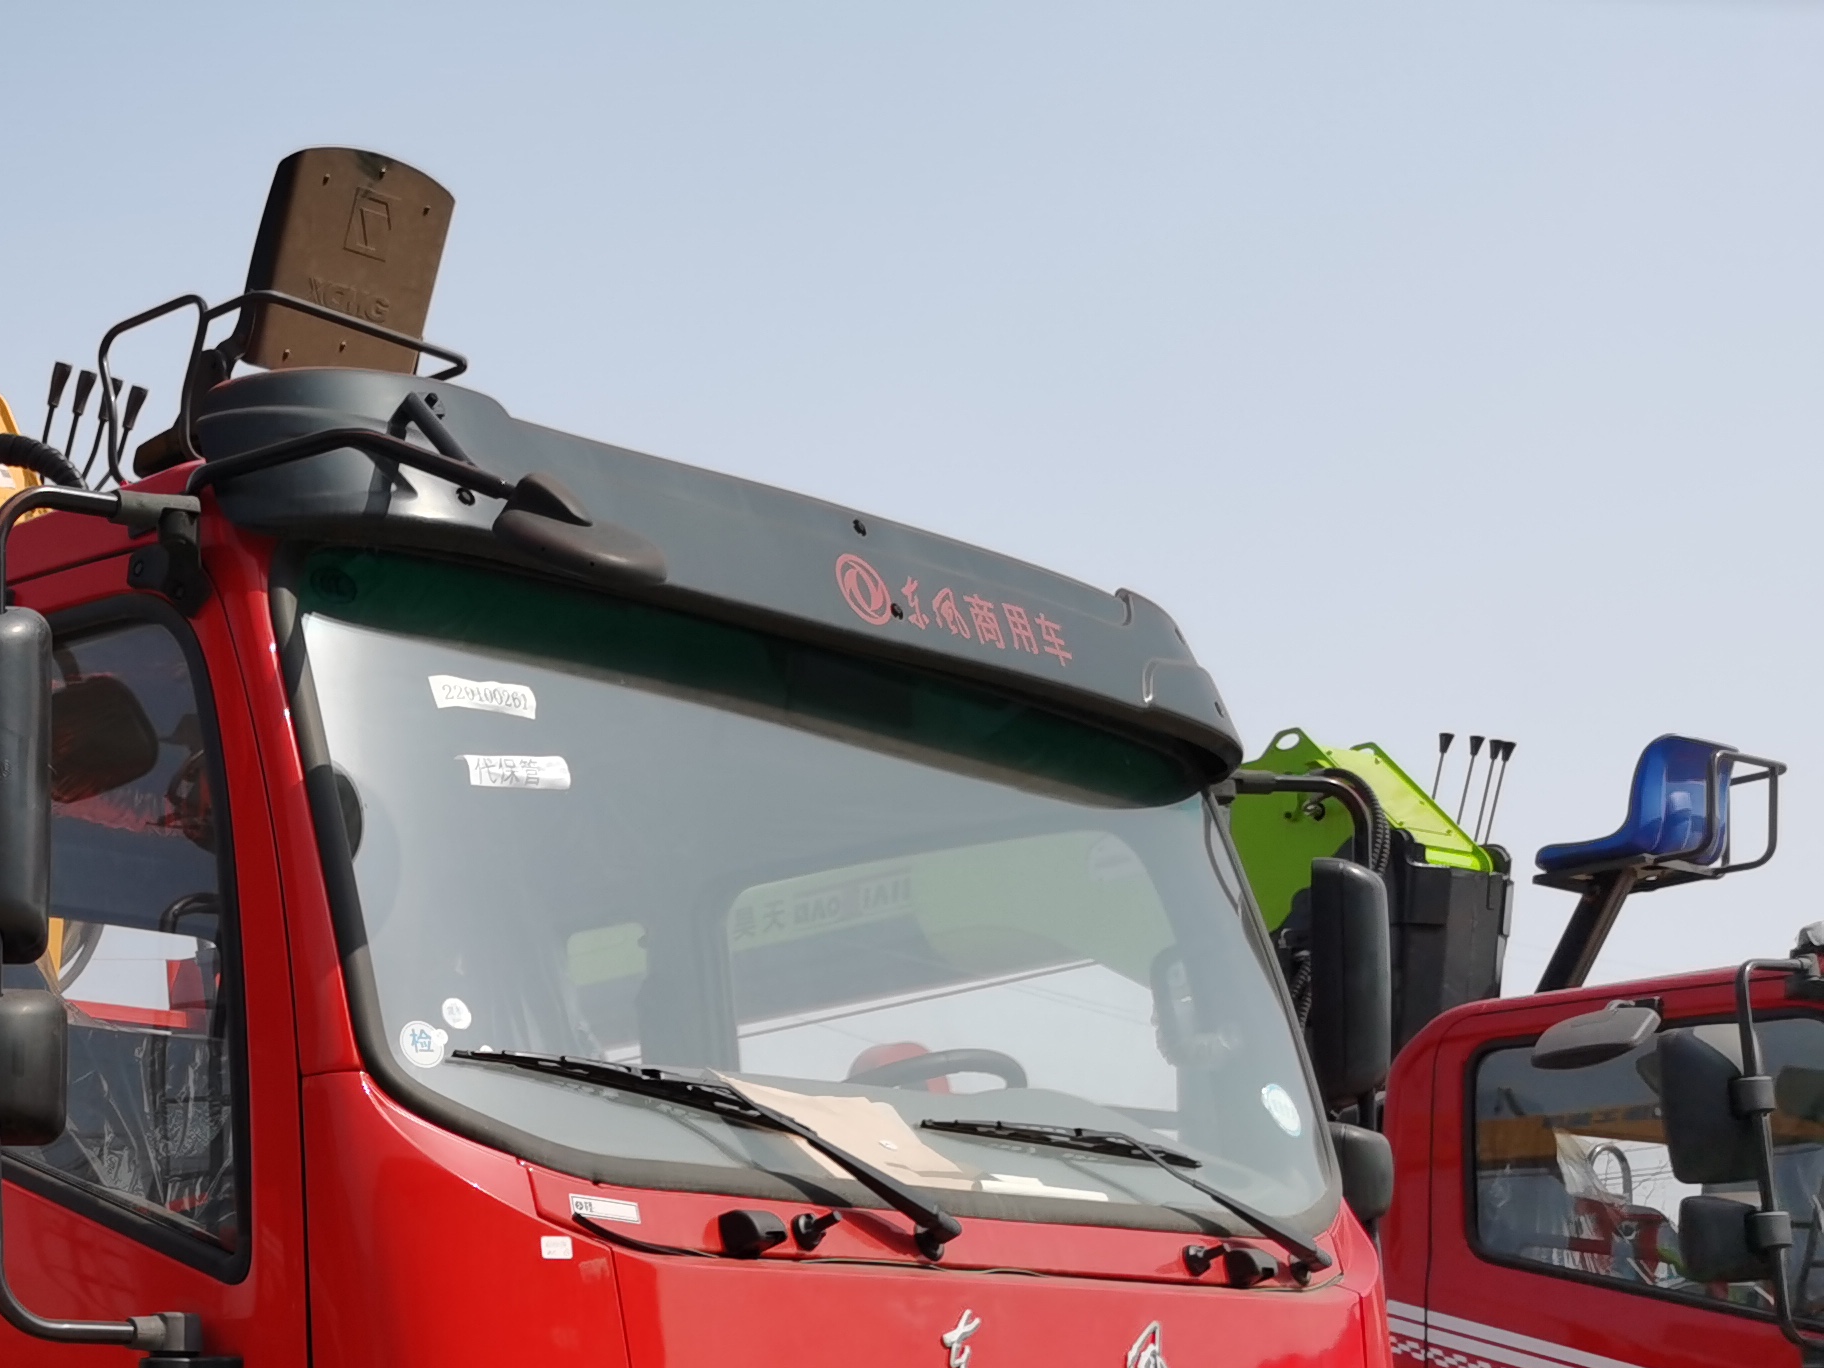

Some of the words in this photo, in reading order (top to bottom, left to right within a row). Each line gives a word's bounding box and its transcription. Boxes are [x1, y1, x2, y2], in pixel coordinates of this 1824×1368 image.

[900, 575, 1073, 667] 东风商用车
